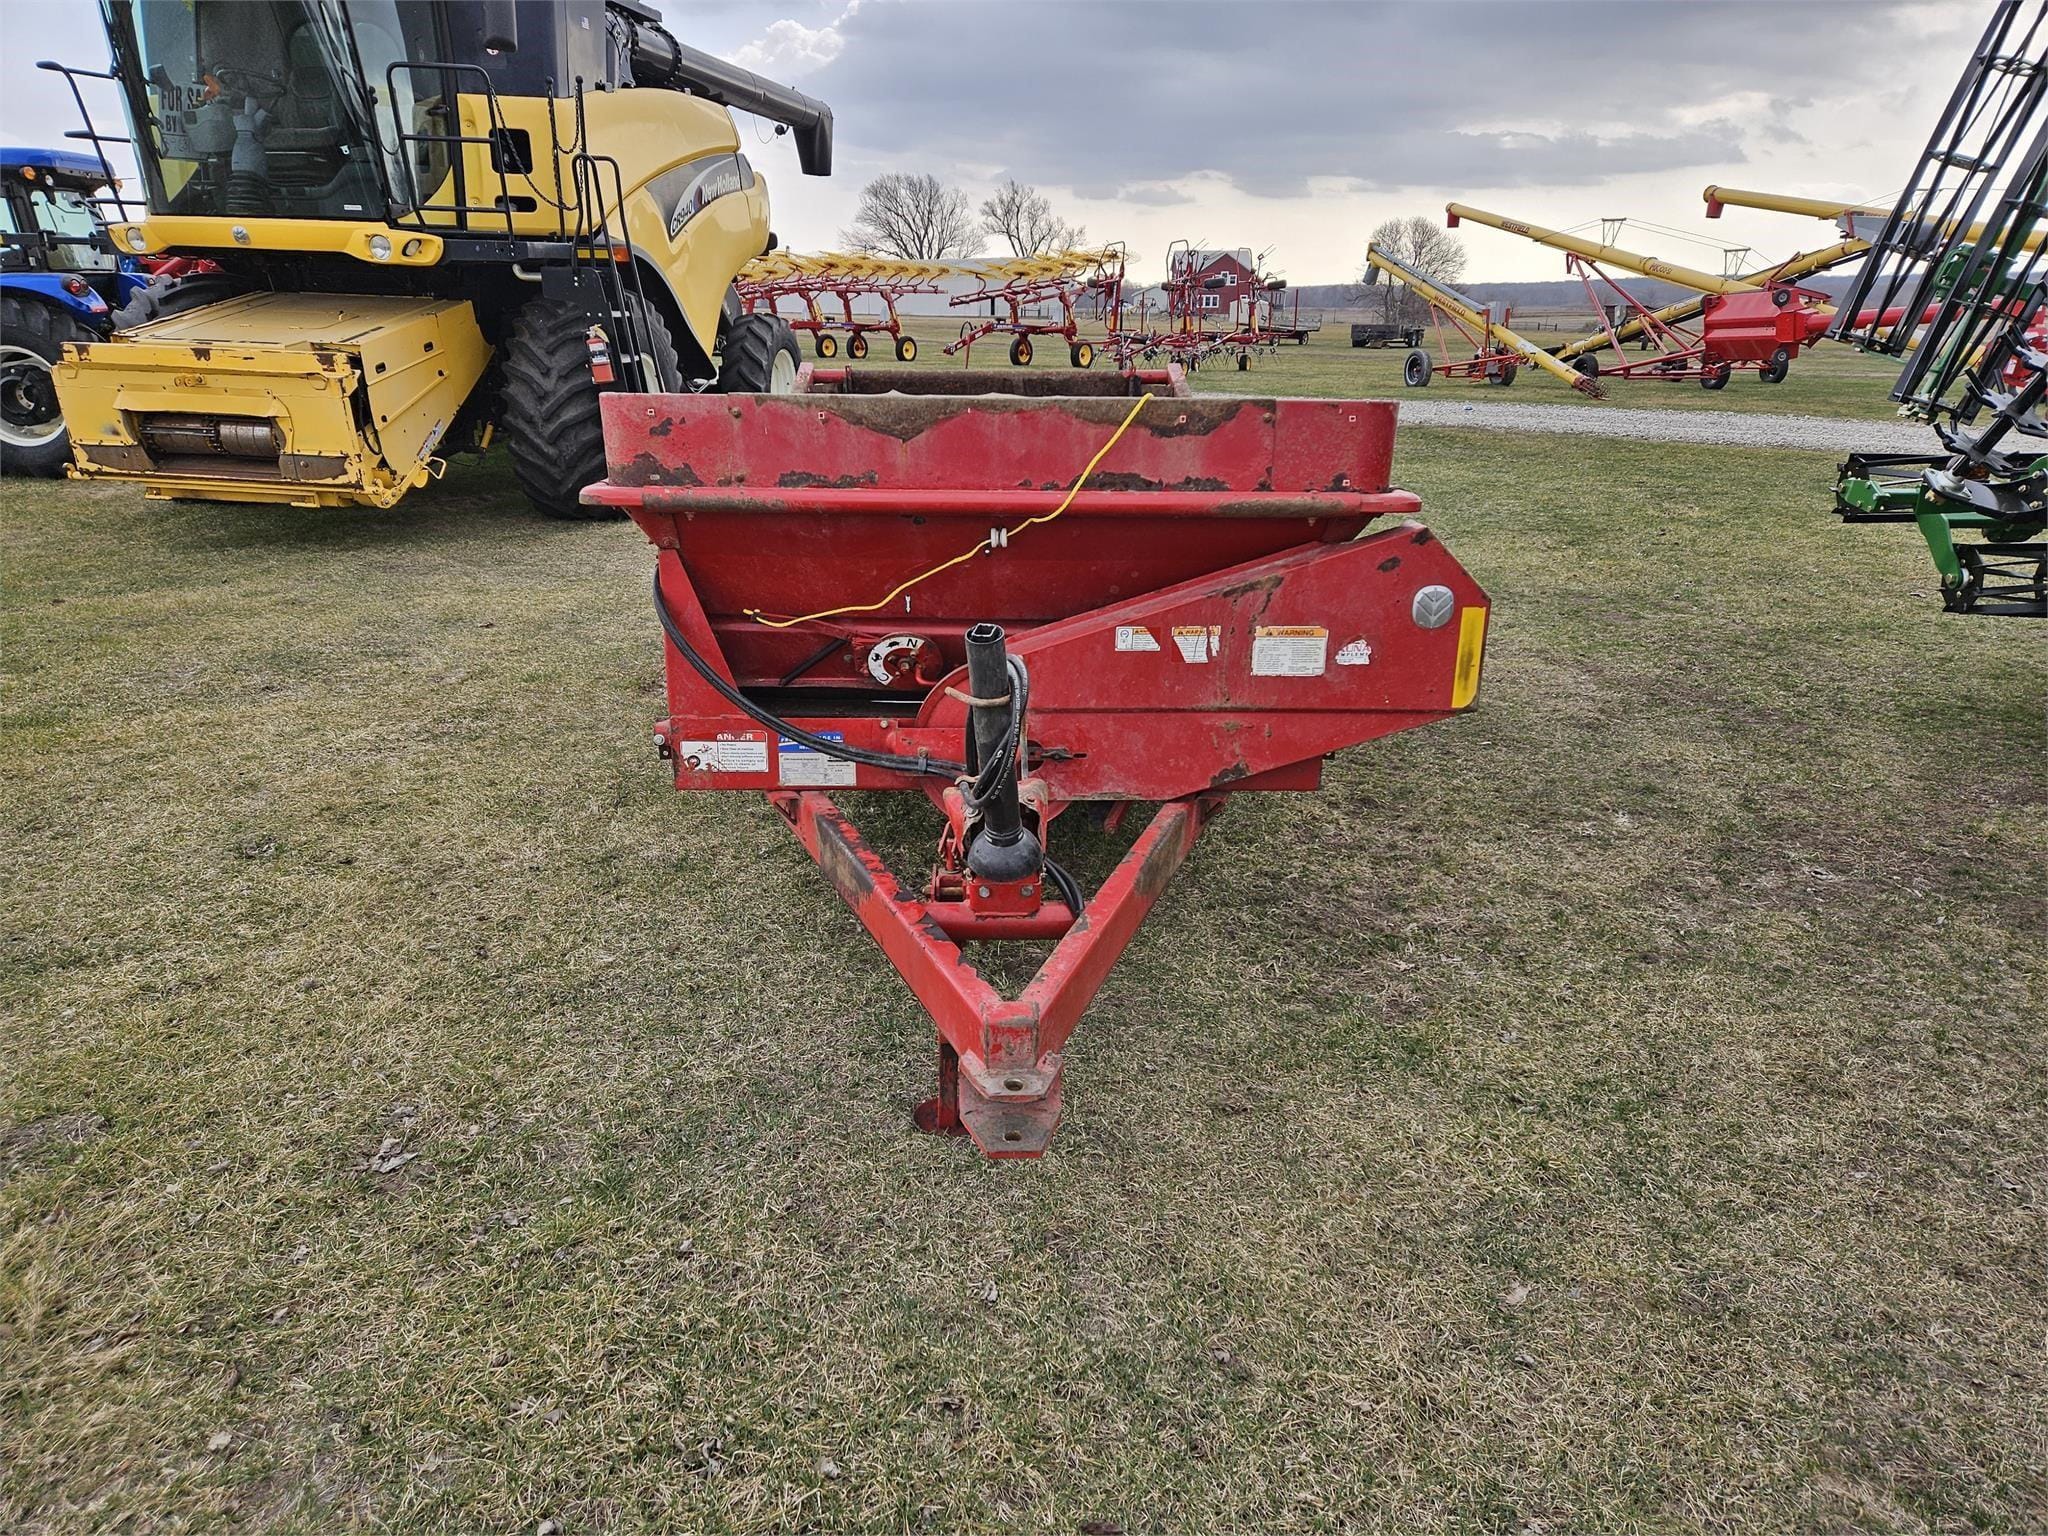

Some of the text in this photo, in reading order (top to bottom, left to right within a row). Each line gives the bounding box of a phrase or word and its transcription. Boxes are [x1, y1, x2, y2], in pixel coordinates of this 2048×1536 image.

[161, 86, 204, 112] FOR SA
[165, 114, 177, 132] BY
[701, 173, 741, 205] New Holland
[671, 199, 693, 233] CR940
[906, 638, 918, 648] N
